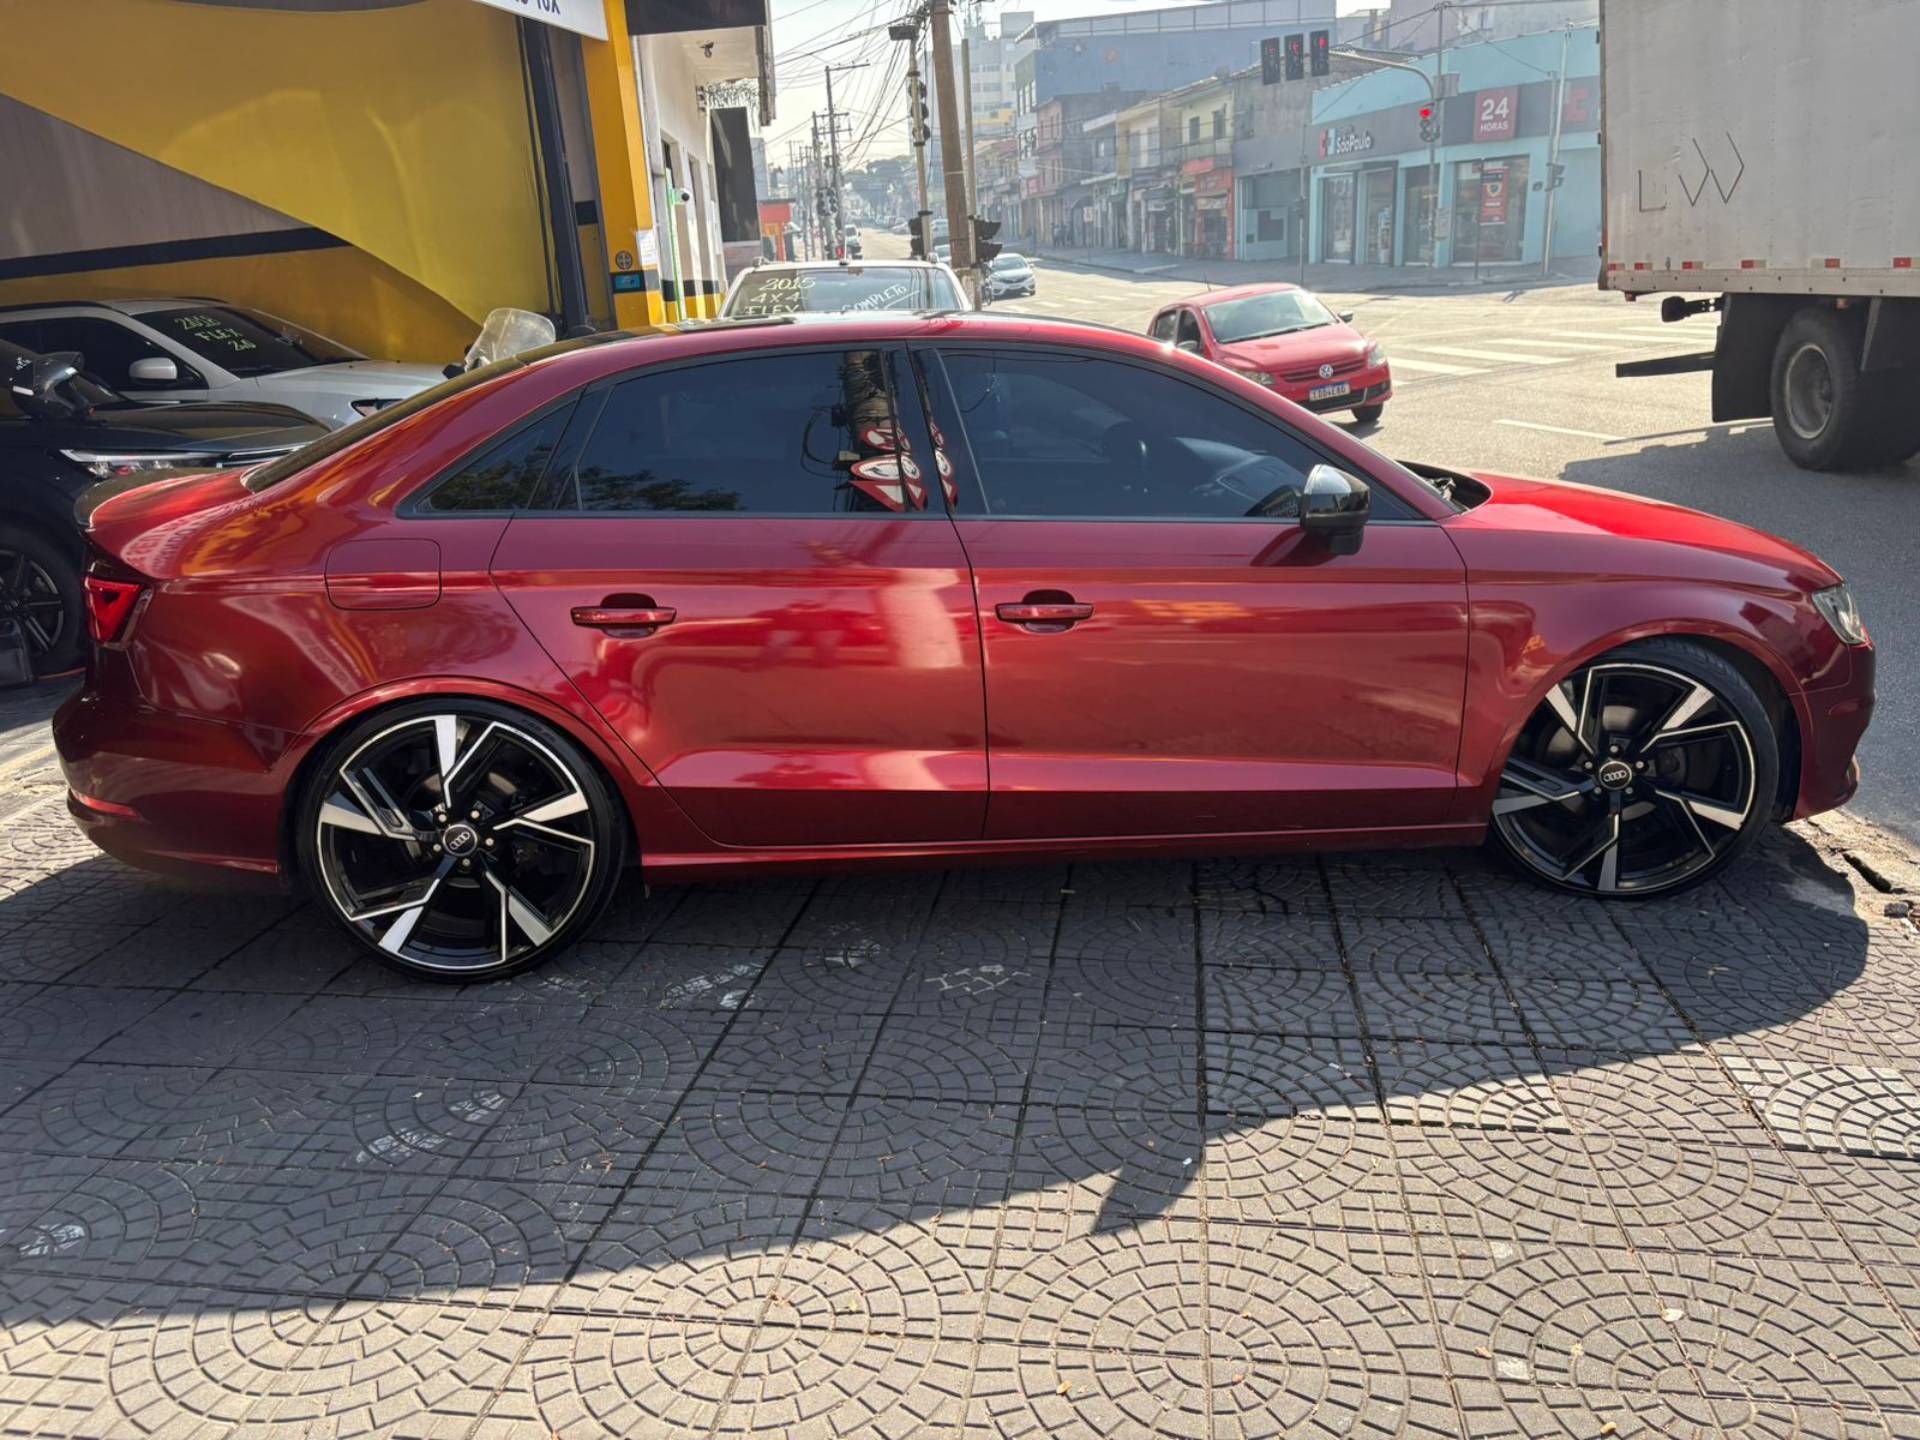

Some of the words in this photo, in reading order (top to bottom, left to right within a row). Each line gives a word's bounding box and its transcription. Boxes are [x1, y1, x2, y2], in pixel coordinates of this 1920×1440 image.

[1481, 96, 1509, 120] 24
[759, 276, 816, 291] 2015
[194, 329, 243, 341] FLEX
